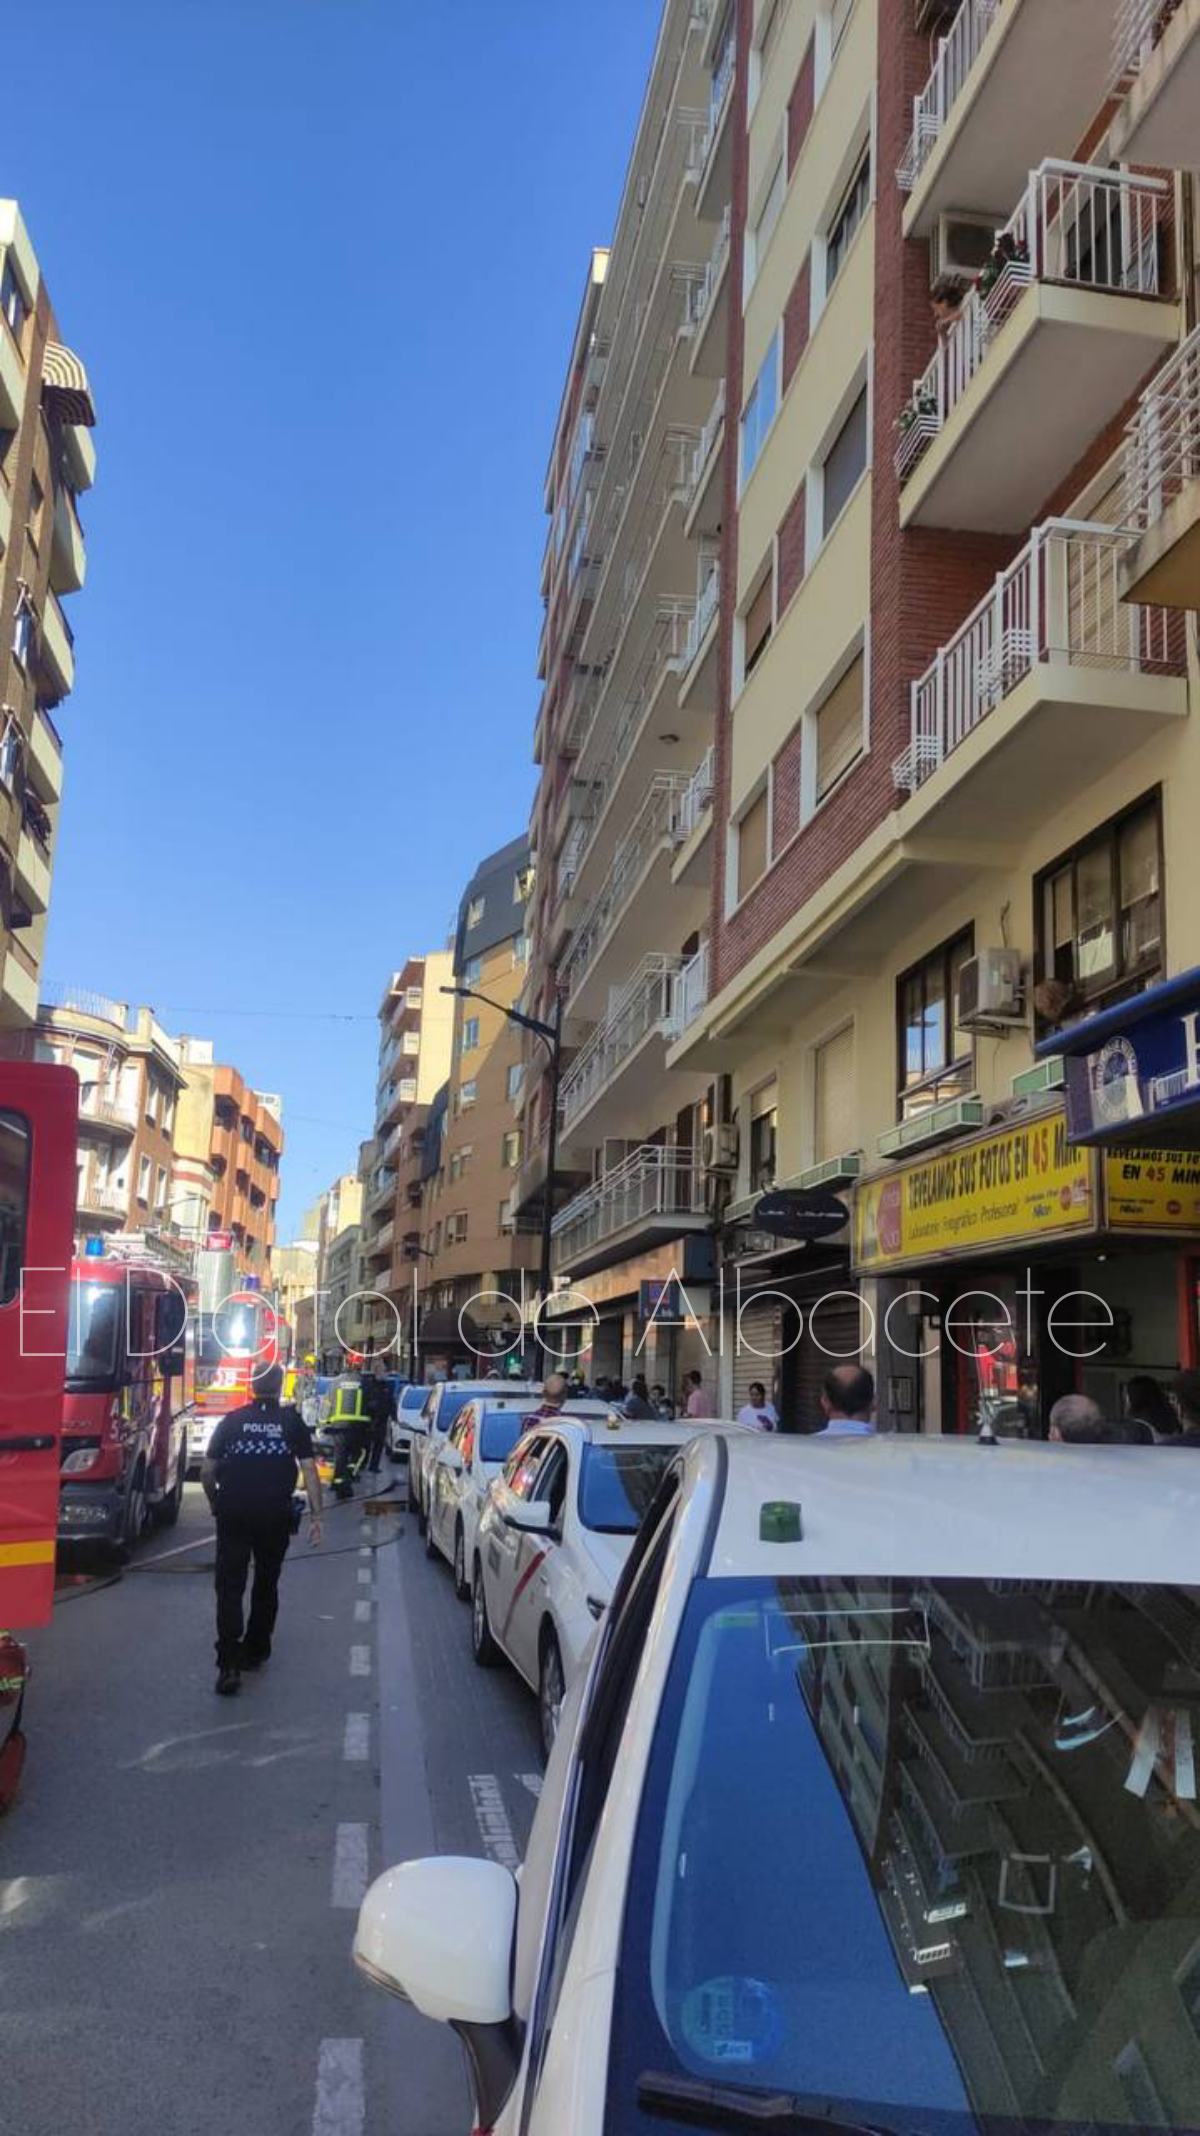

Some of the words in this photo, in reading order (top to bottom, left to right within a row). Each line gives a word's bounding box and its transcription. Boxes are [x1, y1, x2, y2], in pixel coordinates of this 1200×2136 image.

[959, 1150, 976, 1196] SUS
[980, 1138, 1012, 1190] FOTOS
[1014, 1135, 1029, 1181] EN
[1033, 1127, 1049, 1174] 45
[1122, 1164, 1141, 1180] EN
[1145, 1165, 1166, 1183] 45
